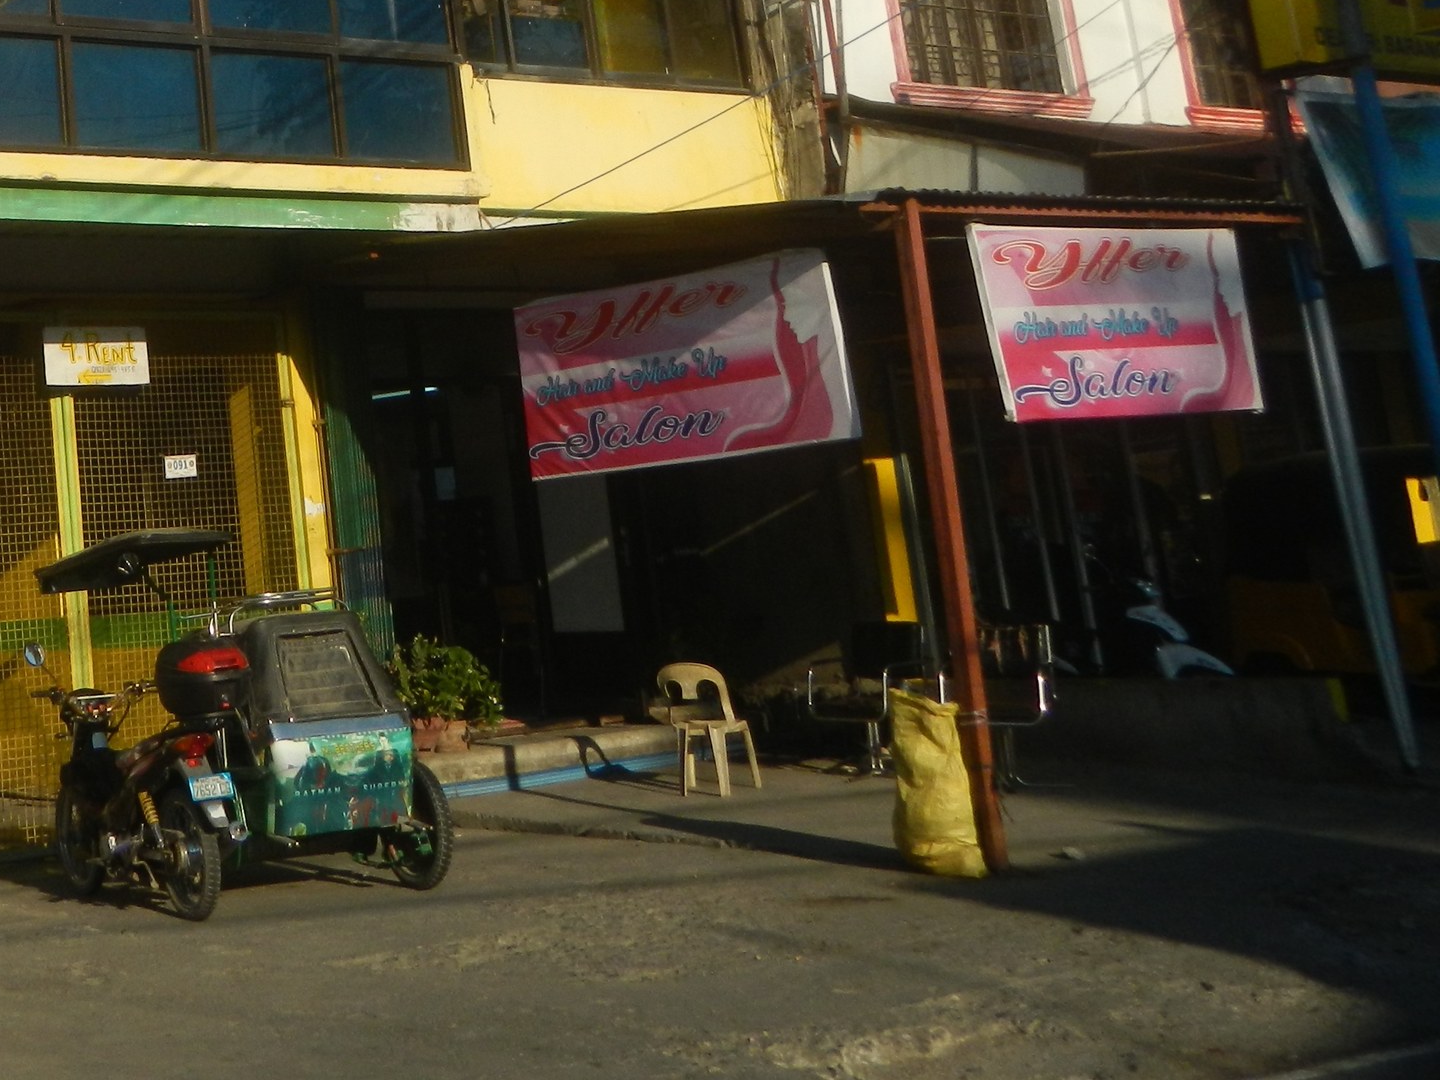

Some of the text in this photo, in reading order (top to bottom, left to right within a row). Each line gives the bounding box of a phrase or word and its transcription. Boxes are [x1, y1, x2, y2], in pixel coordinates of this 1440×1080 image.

[1013, 311, 1058, 345] Hair
[1061, 313, 1088, 337] and
[1091, 308, 1150, 341] Make
[536, 346, 727, 407] Hair and Make Up
[1014, 356, 1176, 408] Salon
[528, 405, 727, 461] Salon
[294, 786, 342, 797] BATMAN
